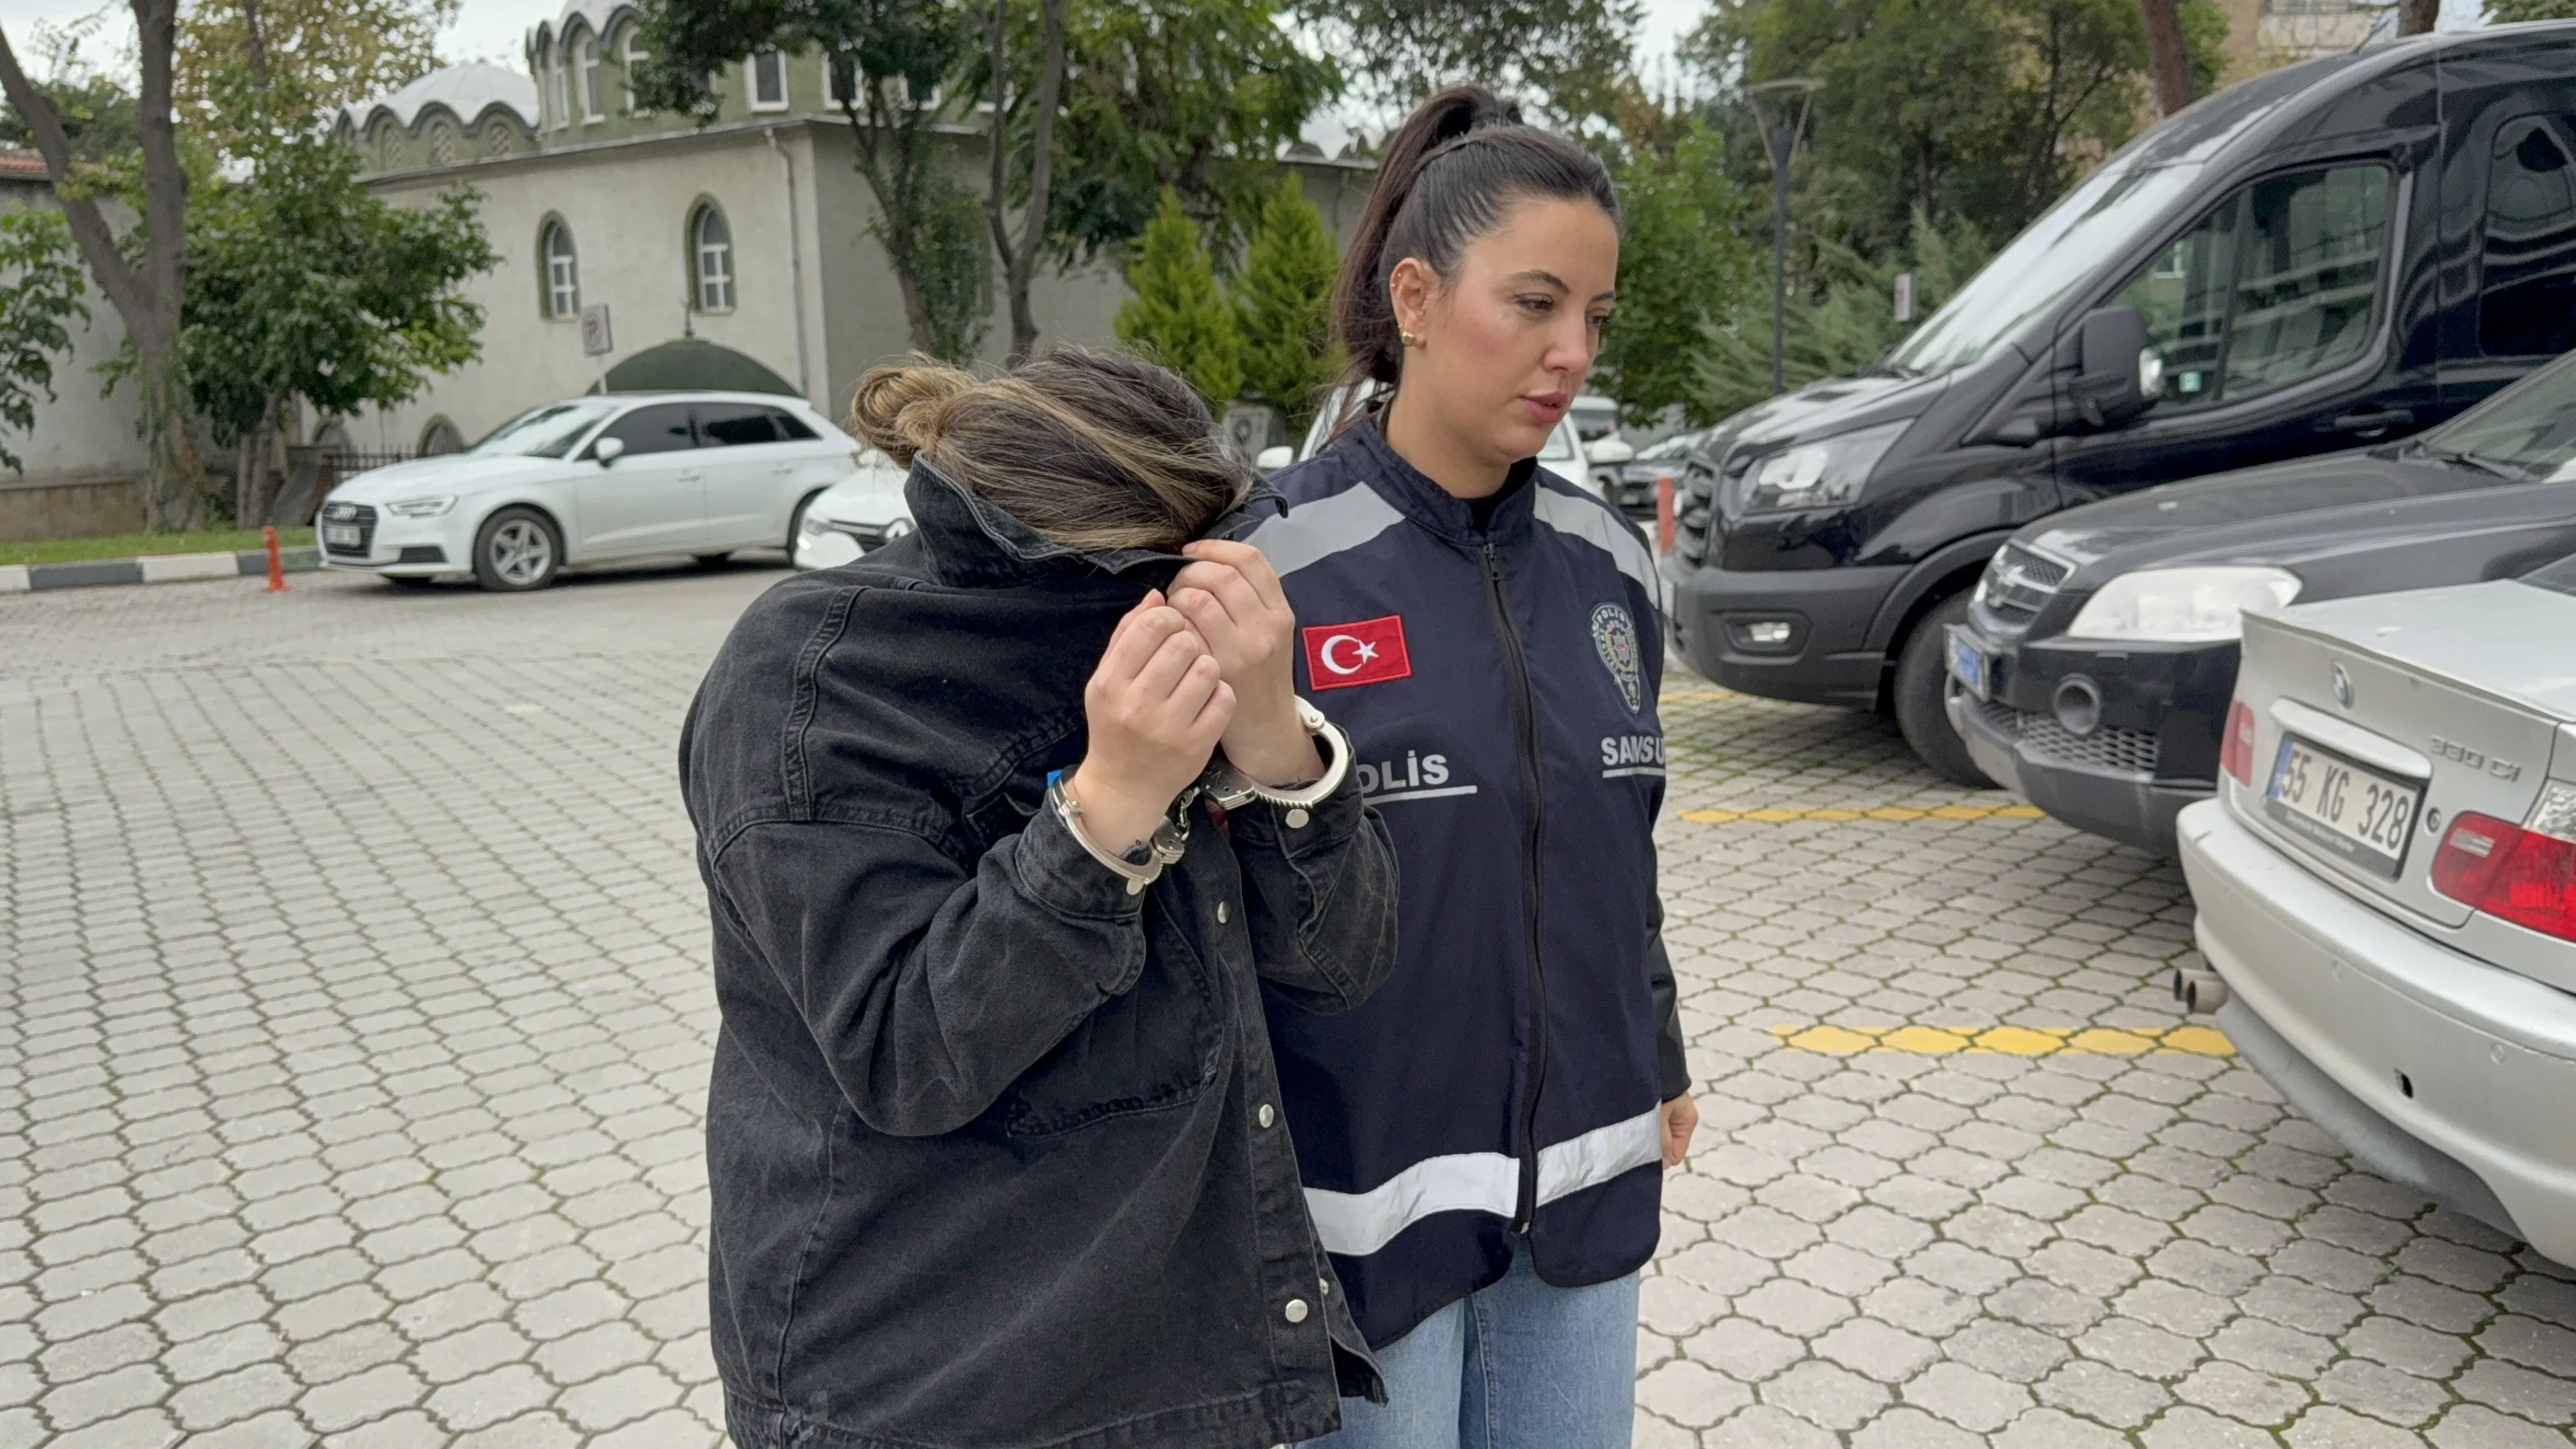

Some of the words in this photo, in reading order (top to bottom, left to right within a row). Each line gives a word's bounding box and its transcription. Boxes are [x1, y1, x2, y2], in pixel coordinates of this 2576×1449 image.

[1357, 749, 1449, 794] OLİS
[1601, 735, 1664, 766] SAMSU
[2282, 749, 2312, 804] 55
[2316, 764, 2349, 823] KG
[2358, 782, 2409, 850] 328
